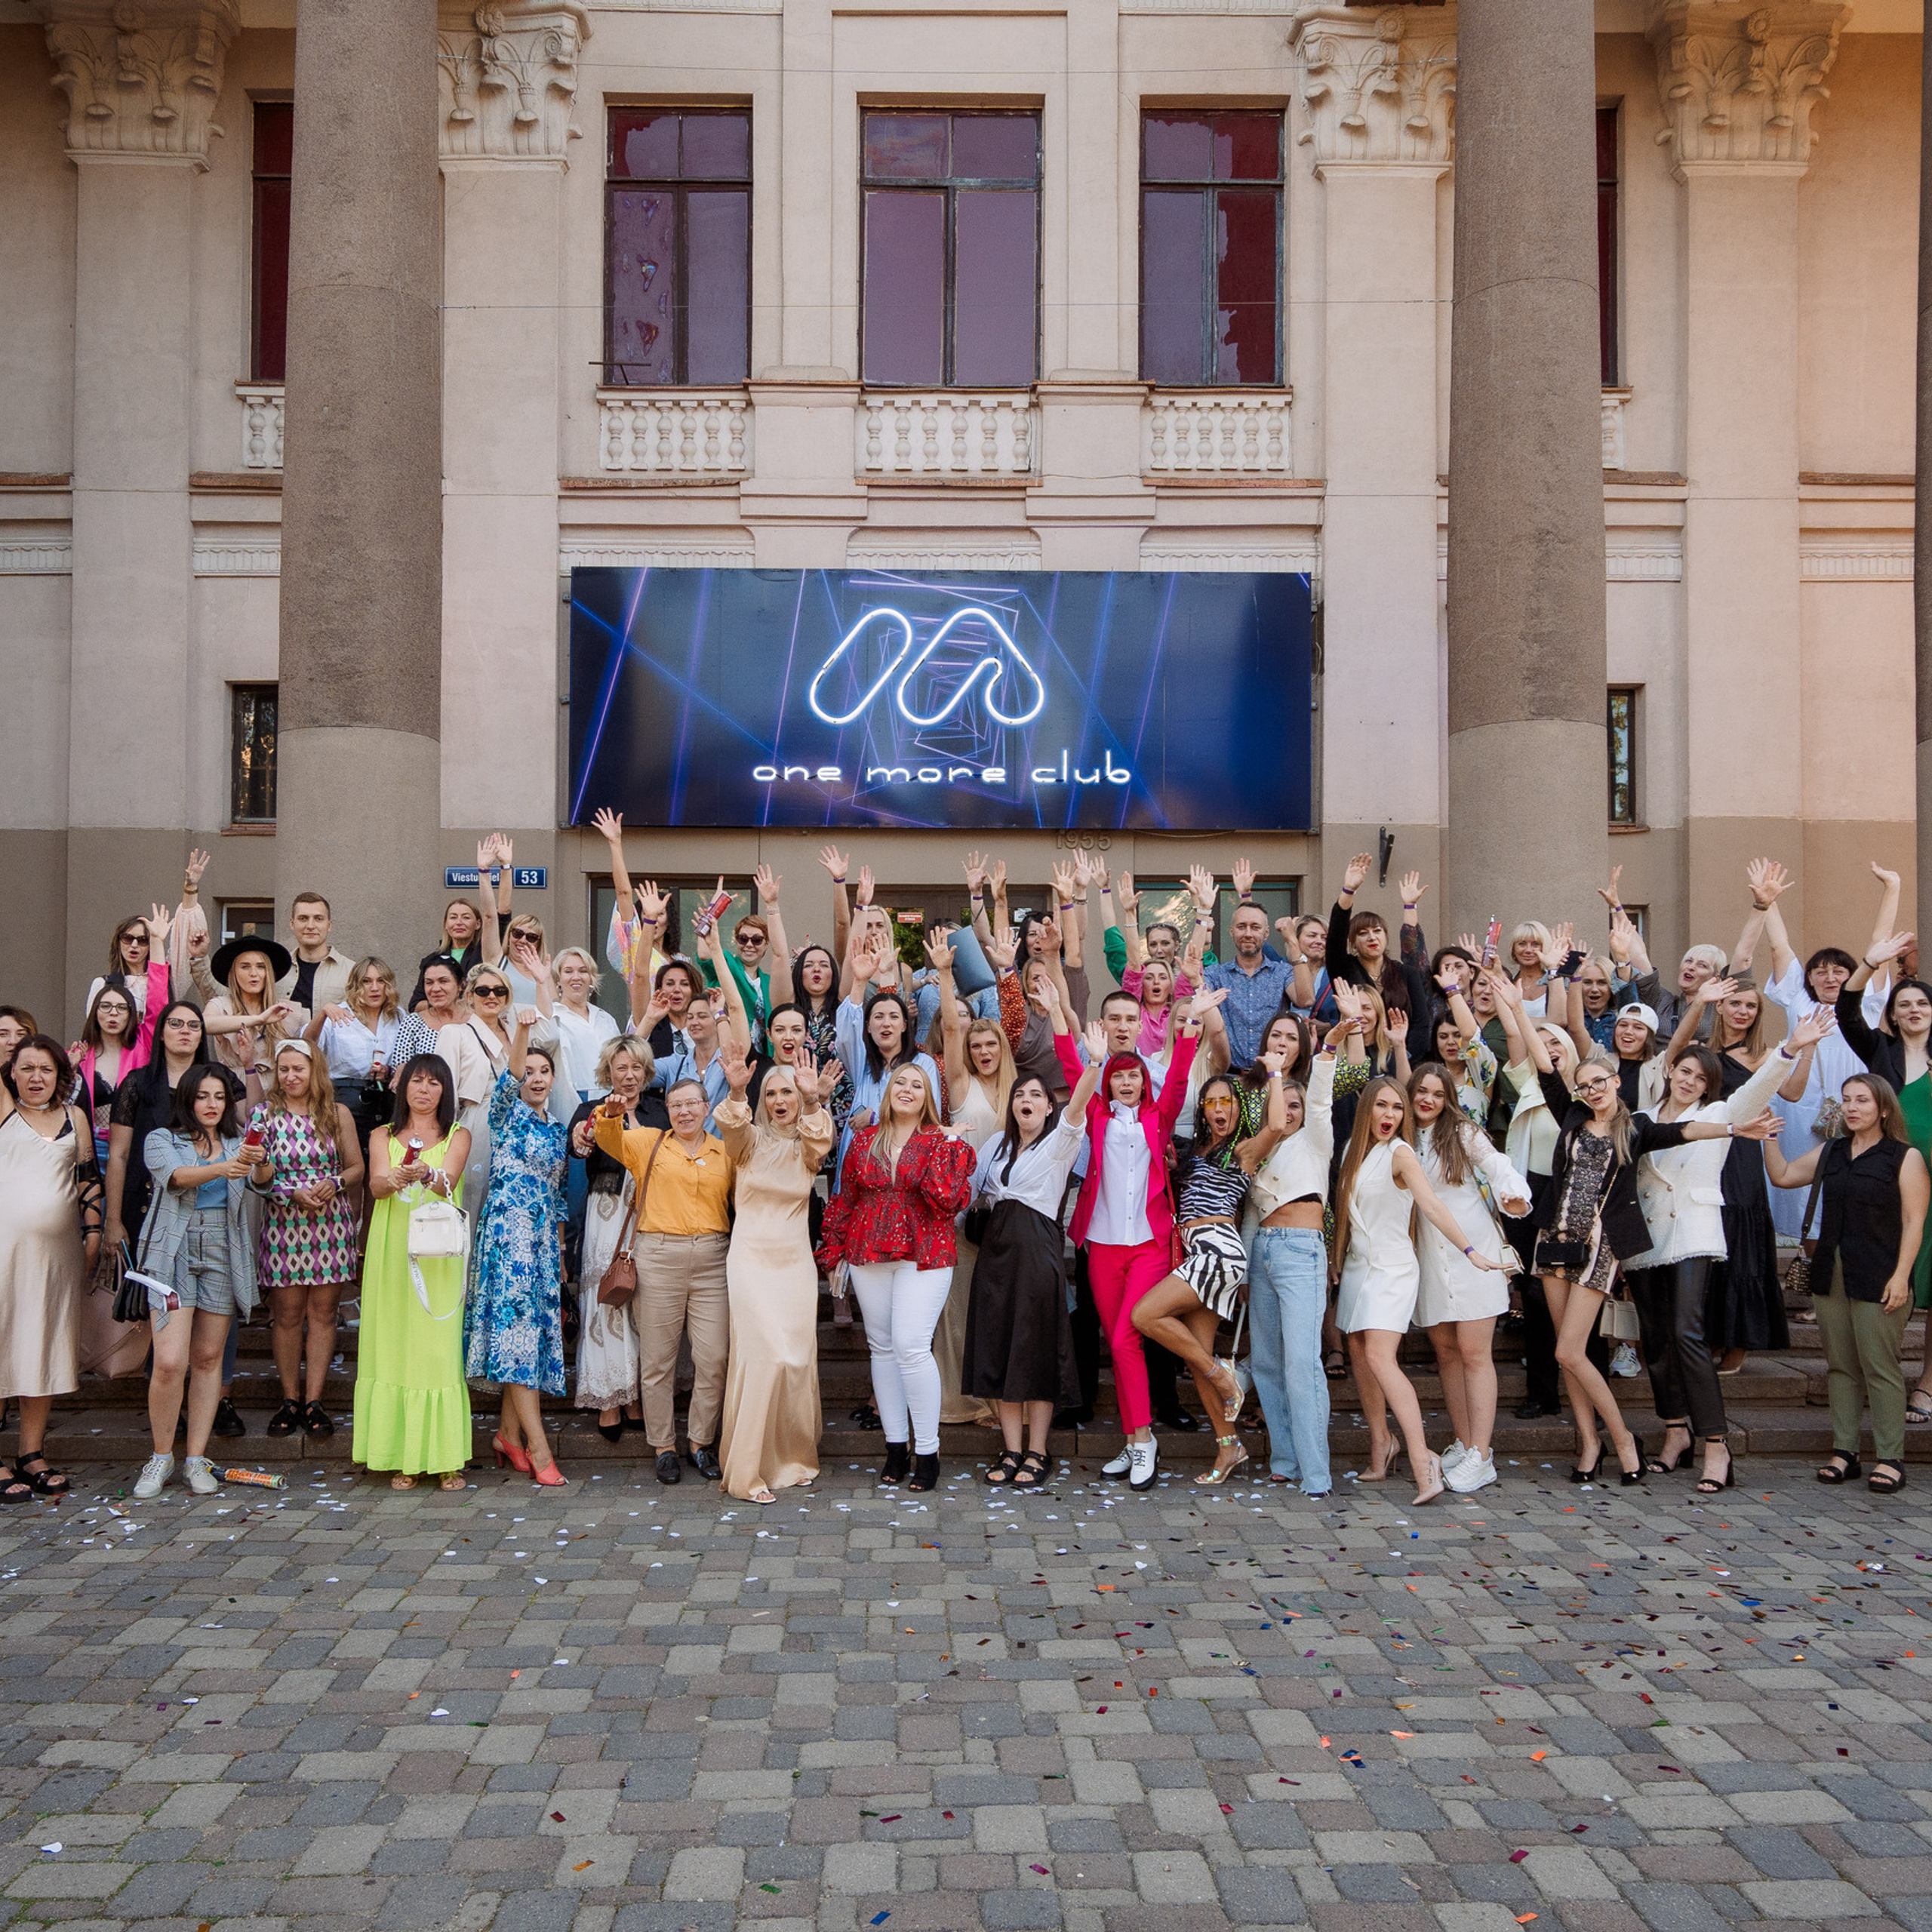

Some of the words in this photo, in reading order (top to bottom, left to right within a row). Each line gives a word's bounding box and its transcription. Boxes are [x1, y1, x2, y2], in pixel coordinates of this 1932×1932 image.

[752, 765, 841, 783] one
[866, 766, 1006, 783] more
[1031, 749, 1131, 783] club
[1057, 830, 1112, 851] 1955
[452, 872, 479, 882] Viestu
[521, 870, 538, 884] 53
